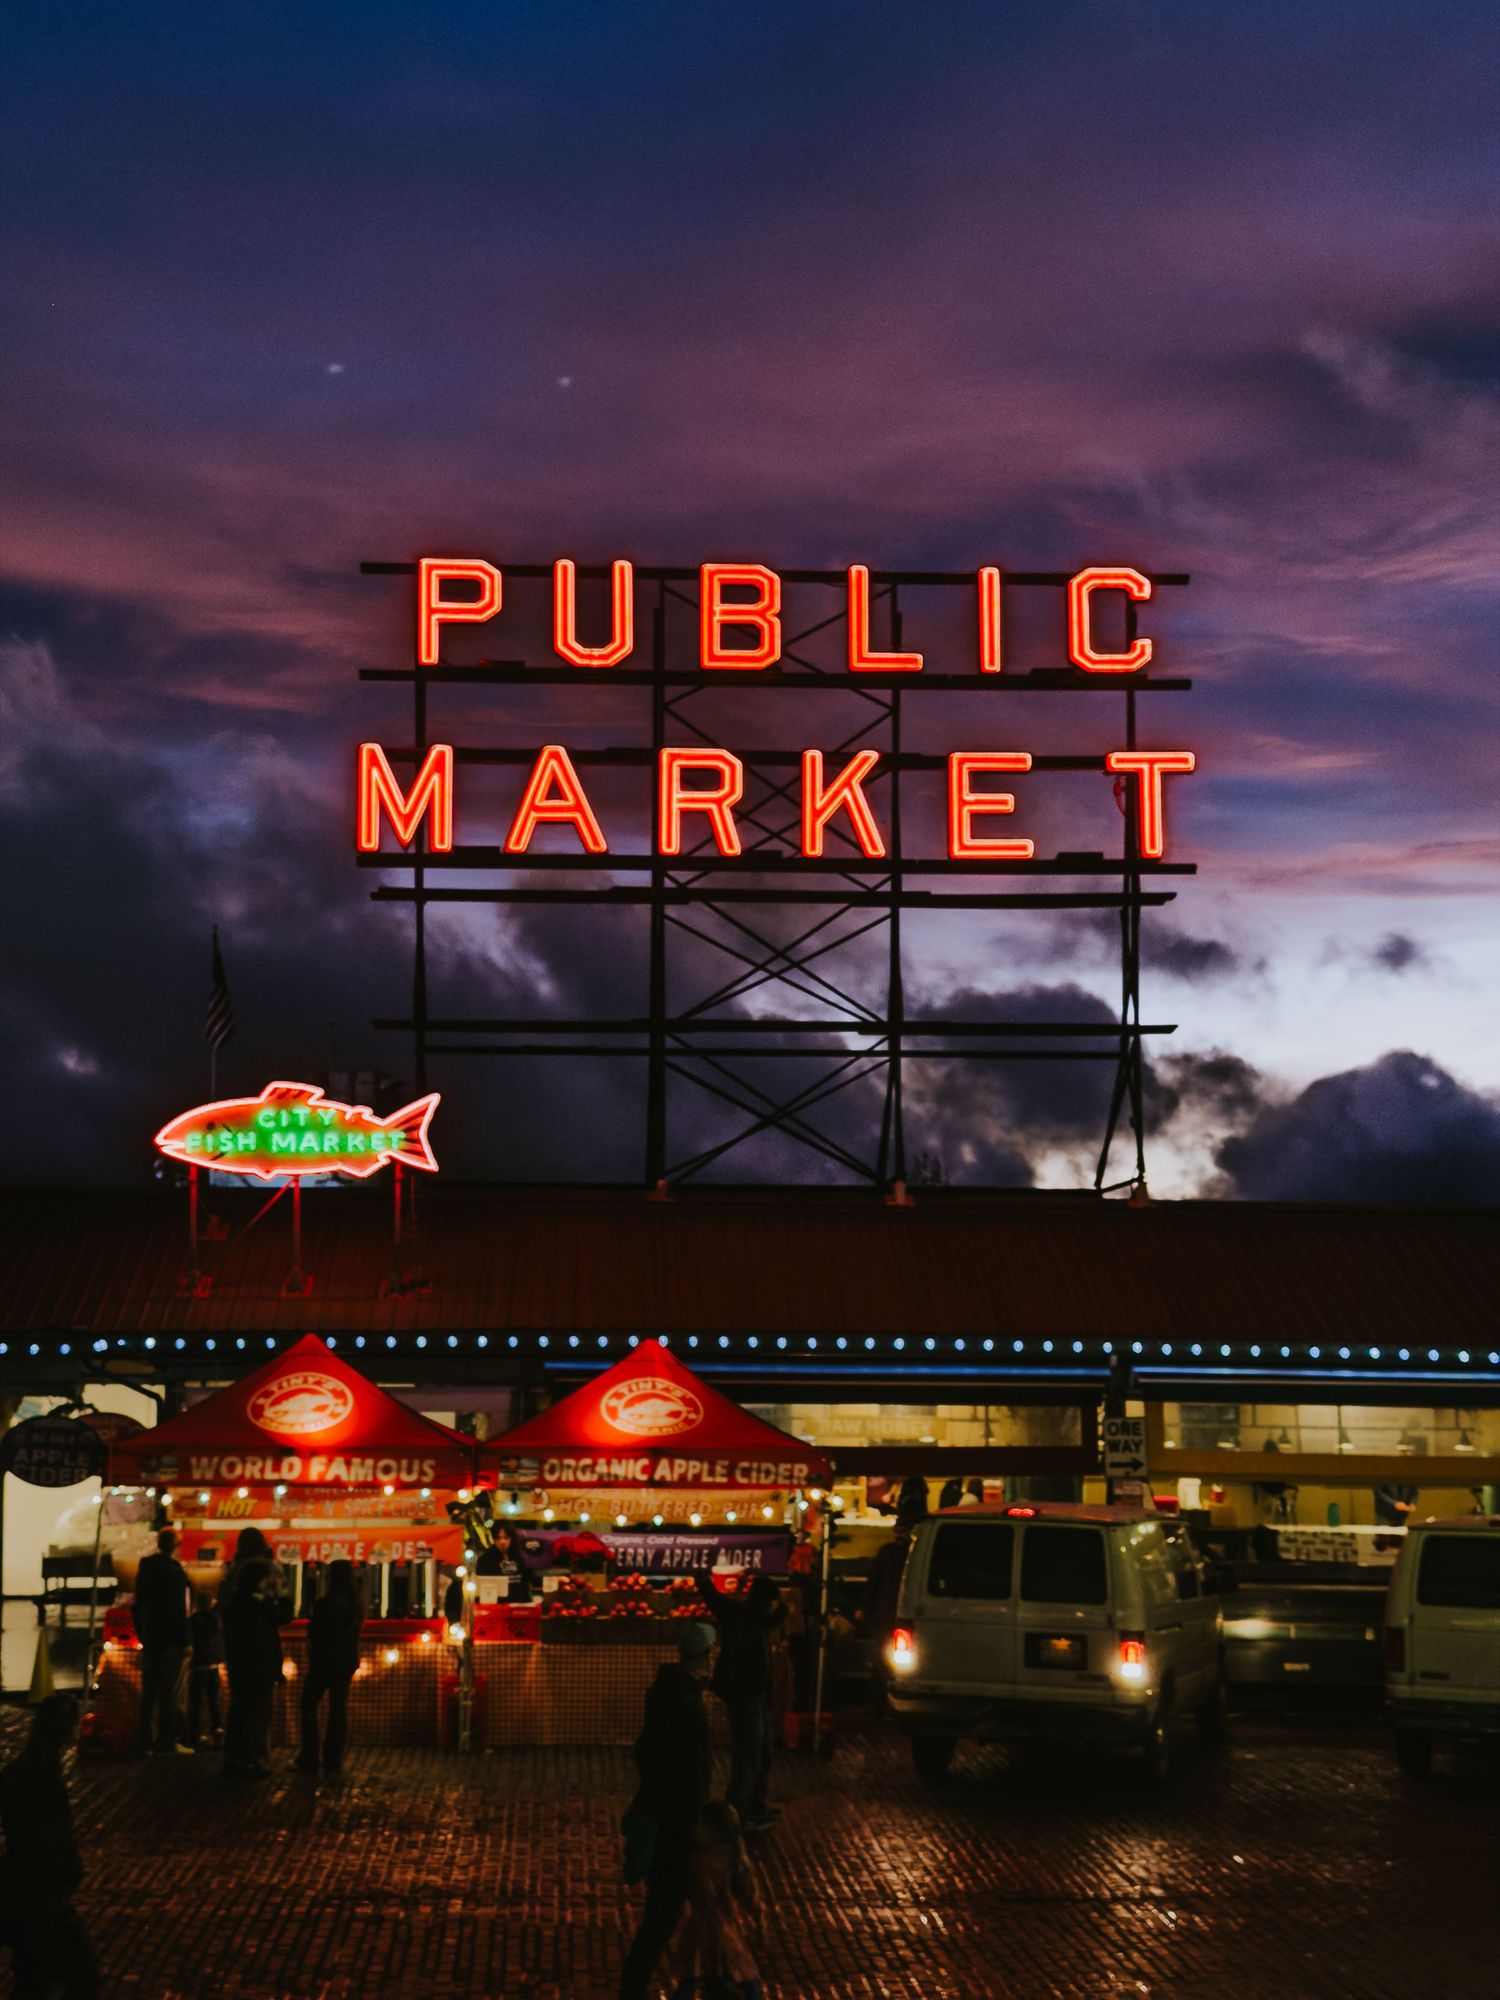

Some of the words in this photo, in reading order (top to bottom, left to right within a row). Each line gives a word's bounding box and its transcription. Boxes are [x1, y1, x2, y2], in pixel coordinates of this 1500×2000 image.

[417, 558, 1152, 673] PUBLIC
[357, 743, 1196, 860] MARKET
[255, 1106, 338, 1129] CITY
[184, 1131, 258, 1153] FISH
[271, 1131, 407, 1154] MARKET
[618, 1381, 685, 1398] TINY'S
[865, 1418, 931, 1435] HONEY
[1107, 1421, 1141, 1436] ONE
[1108, 1439, 1142, 1453] WAY
[13, 1447, 89, 1466] APPLE
[14, 1463, 89, 1485] CIDER
[190, 1455, 302, 1480] WORLD
[309, 1455, 436, 1482] FAMOUS
[543, 1457, 649, 1482] ORGANIC
[653, 1457, 729, 1483] APPLE
[734, 1461, 809, 1485] CIDER
[216, 1499, 259, 1518] HOT
[558, 1498, 600, 1515] HOT
[306, 1541, 365, 1561] APPLE
[661, 1548, 709, 1568] APPLE
[717, 1549, 762, 1569] IDER
